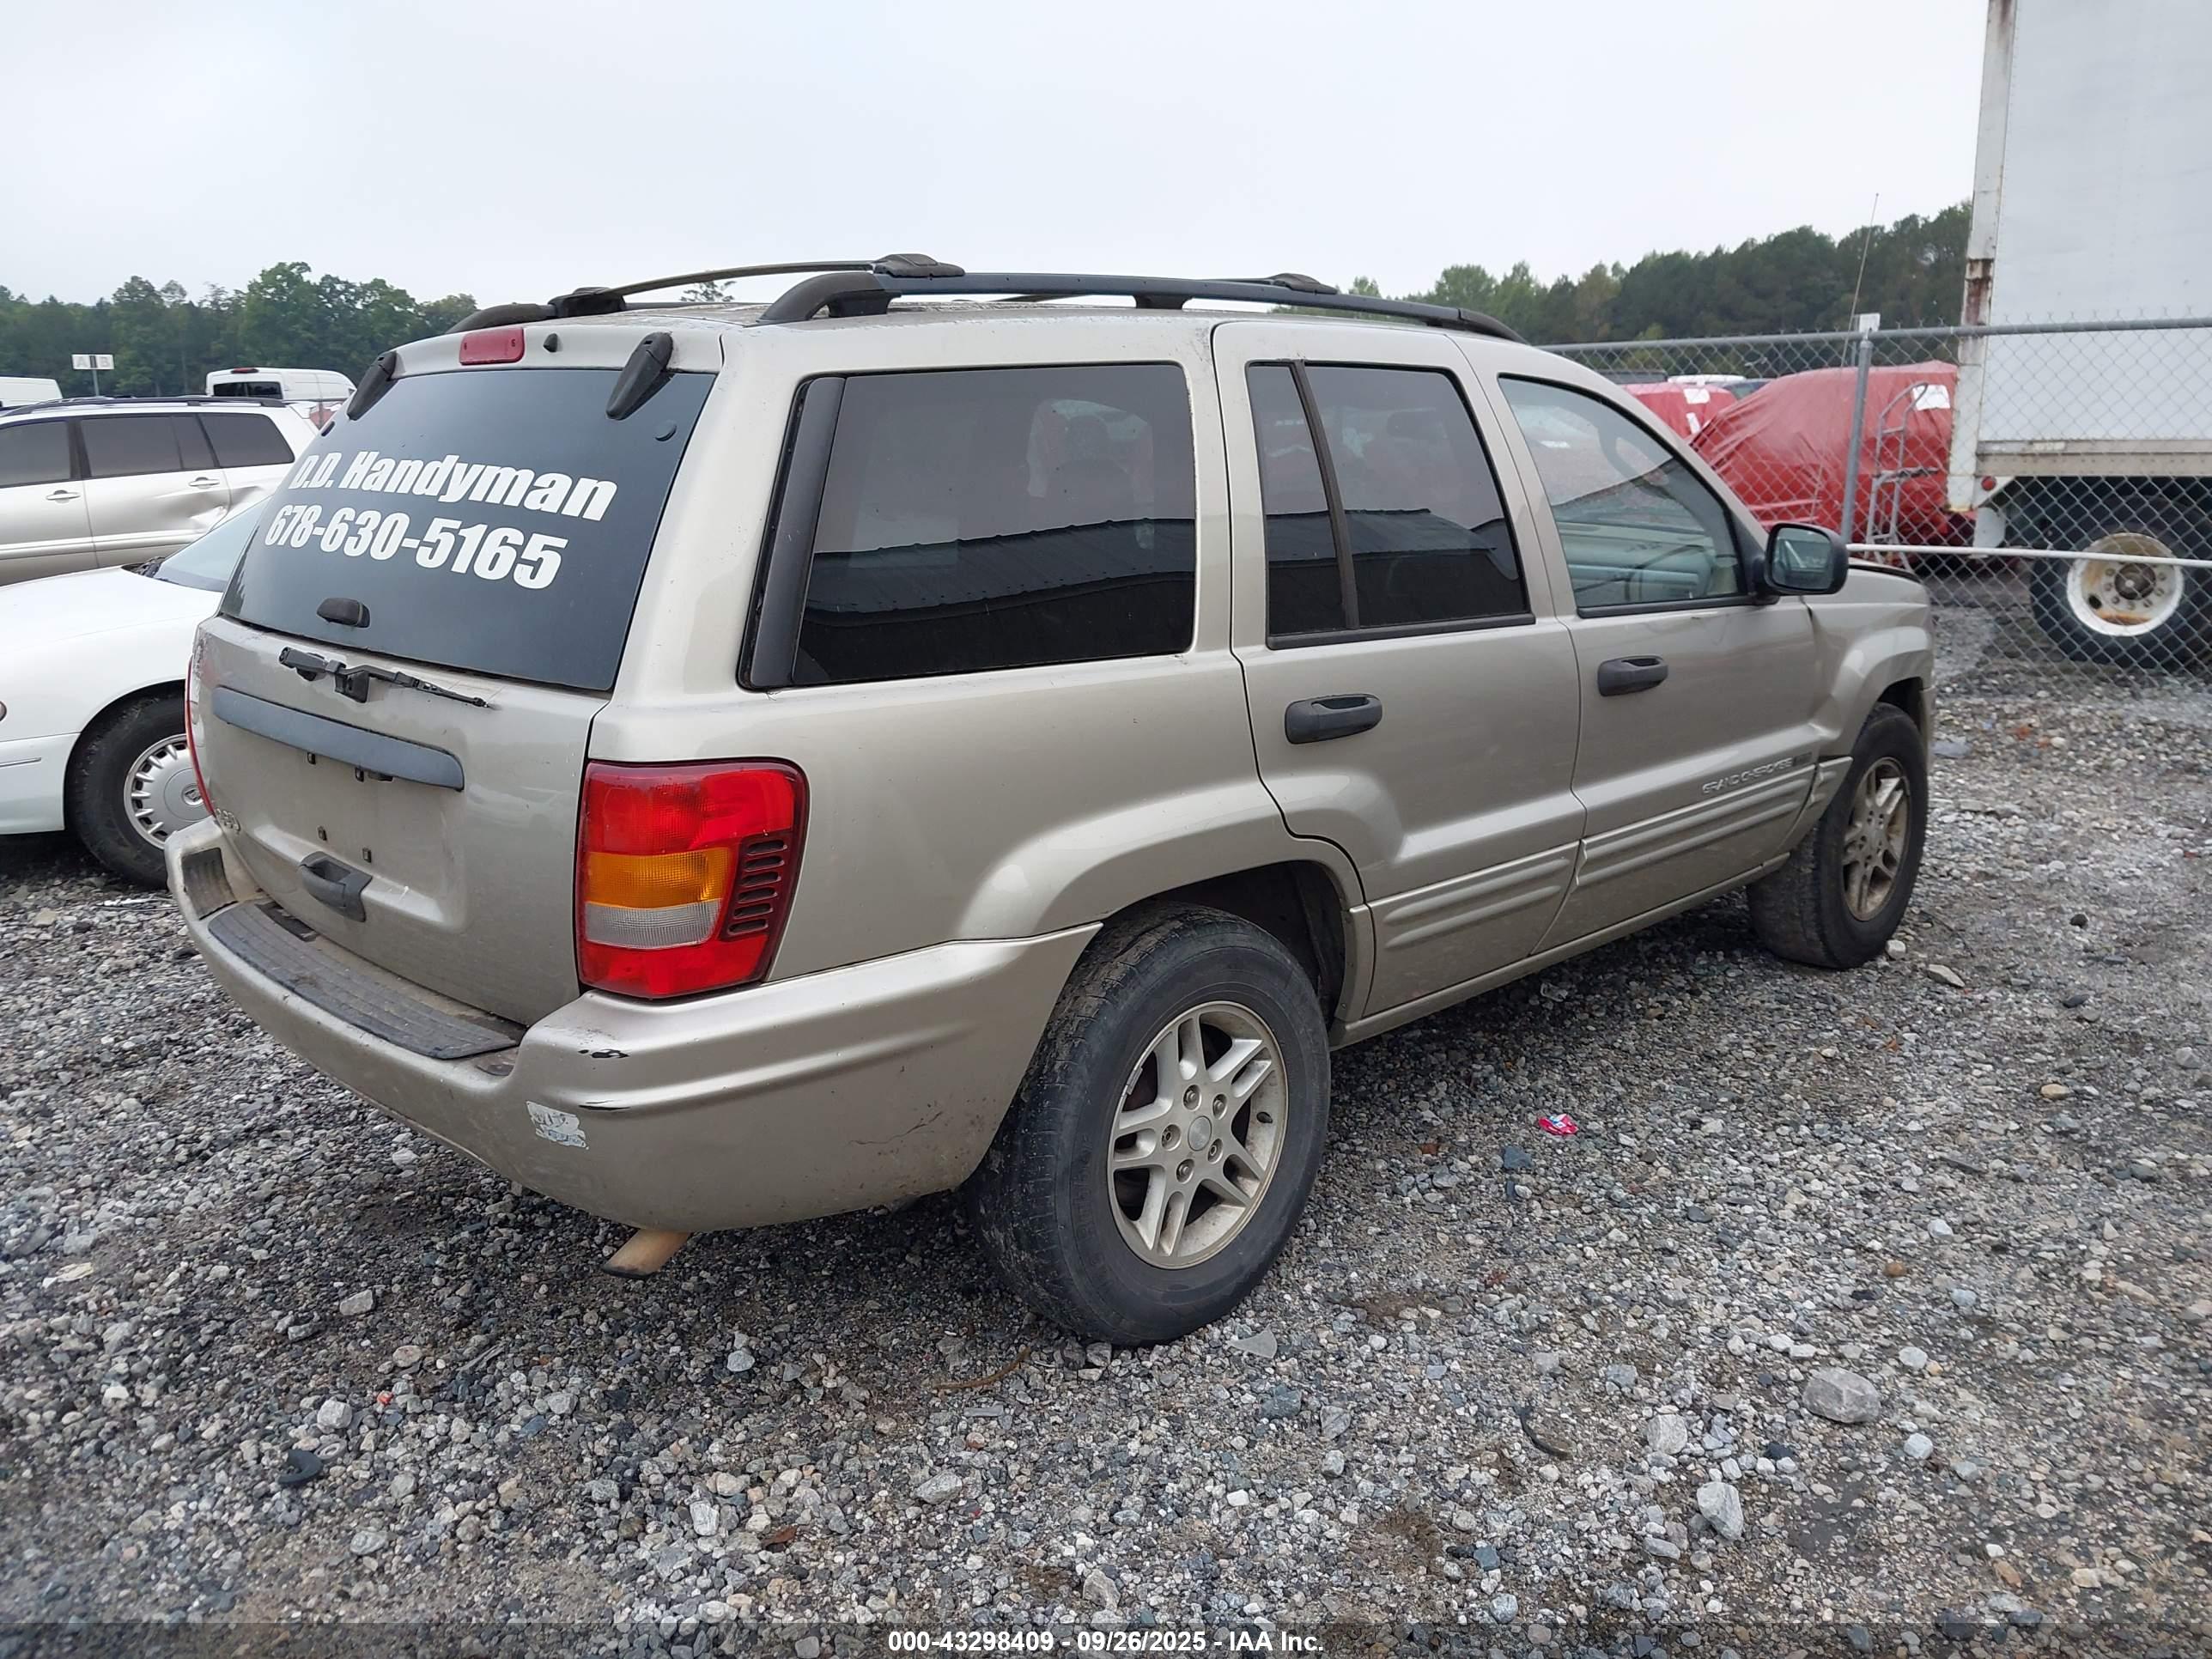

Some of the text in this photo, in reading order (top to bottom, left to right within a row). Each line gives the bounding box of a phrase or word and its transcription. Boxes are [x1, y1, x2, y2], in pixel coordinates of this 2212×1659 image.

[289, 450, 617, 522] D.D. Handyman
[264, 504, 568, 590] 678-630-5165
